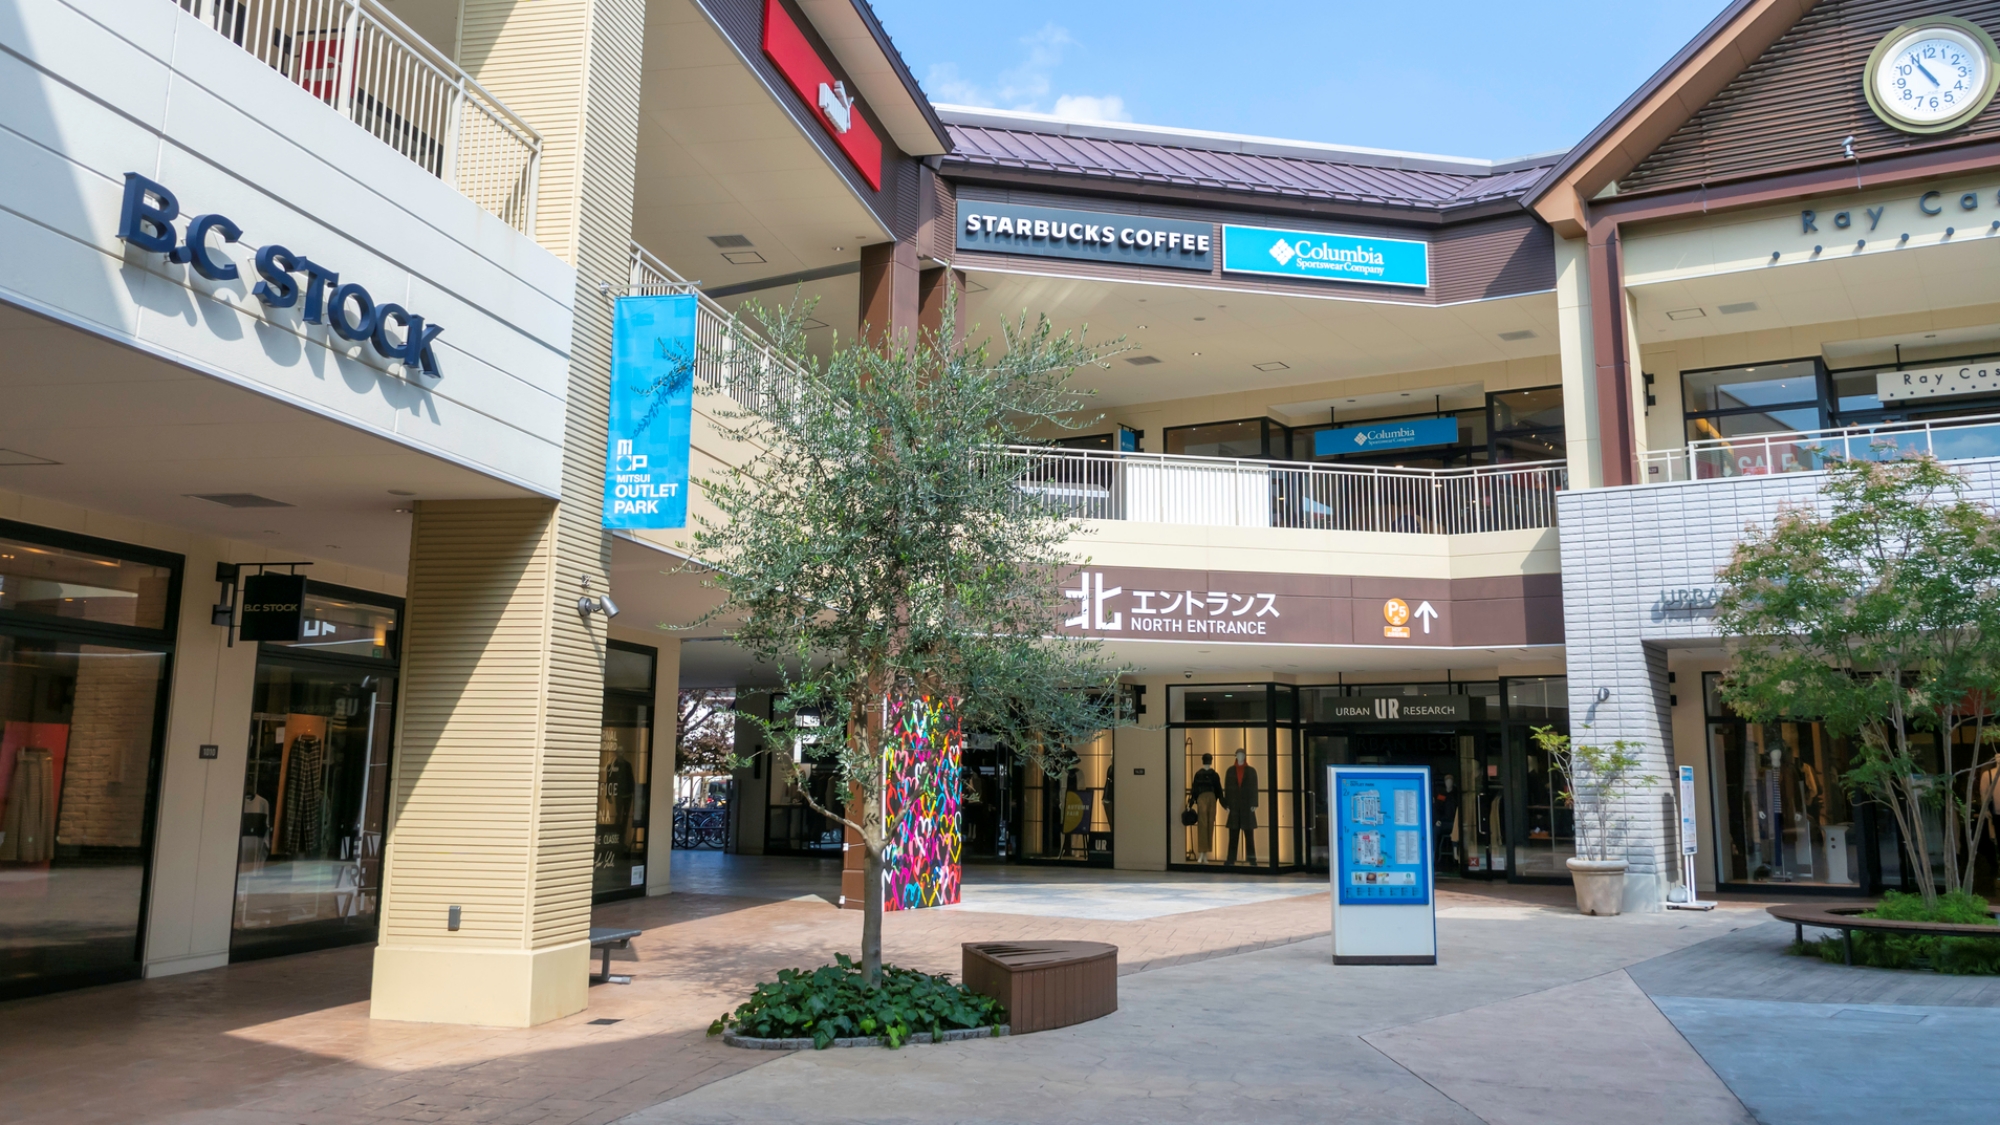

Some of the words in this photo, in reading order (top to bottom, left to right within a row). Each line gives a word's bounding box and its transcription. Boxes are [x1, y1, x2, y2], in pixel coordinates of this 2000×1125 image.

[1922, 47, 1936, 59] 12
[1941, 48, 1946, 59] 1
[1951, 54, 1960, 65] 2
[1900, 65, 1912, 76] 10
[1957, 66, 1967, 78] 3
[1896, 78, 1906, 89] 9
[1953, 80, 1963, 91] 4
[1902, 89, 1913, 100] 8
[1944, 91, 1954, 102] 5
[1915, 96, 1924, 107] 7
[1929, 96, 1939, 108] 6
[1801, 206, 1884, 234] Ray
[1919, 190, 2000, 217] Ca
[966, 213, 1116, 243] STARBUCKS
[1120, 228, 1210, 251] COFFEE
[1294, 240, 1385, 266] Columbia
[1296, 258, 1343, 271] Sportswear
[1343, 261, 1385, 276] Company
[115, 171, 243, 281] B.C
[252, 244, 445, 379] STOCK
[1903, 372, 1943, 386] Ray
[1367, 427, 1415, 441] Columbia
[616, 474, 650, 483] MITSUI
[615, 483, 679, 498] OUTLET
[614, 500, 659, 514] PARK
[1065, 571, 1122, 631] 北
[1660, 587, 1724, 606] URBA
[263, 603, 298, 612] STOCK
[1131, 590, 1281, 618] エントランス
[1131, 617, 1182, 633] NORTH
[1187, 619, 1266, 635] ENTRANCE
[1335, 707, 1370, 716] URBAN
[1374, 698, 1399, 719] UR
[1403, 706, 1455, 716] RESEARCH
[1095, 839, 1107, 851] UR
